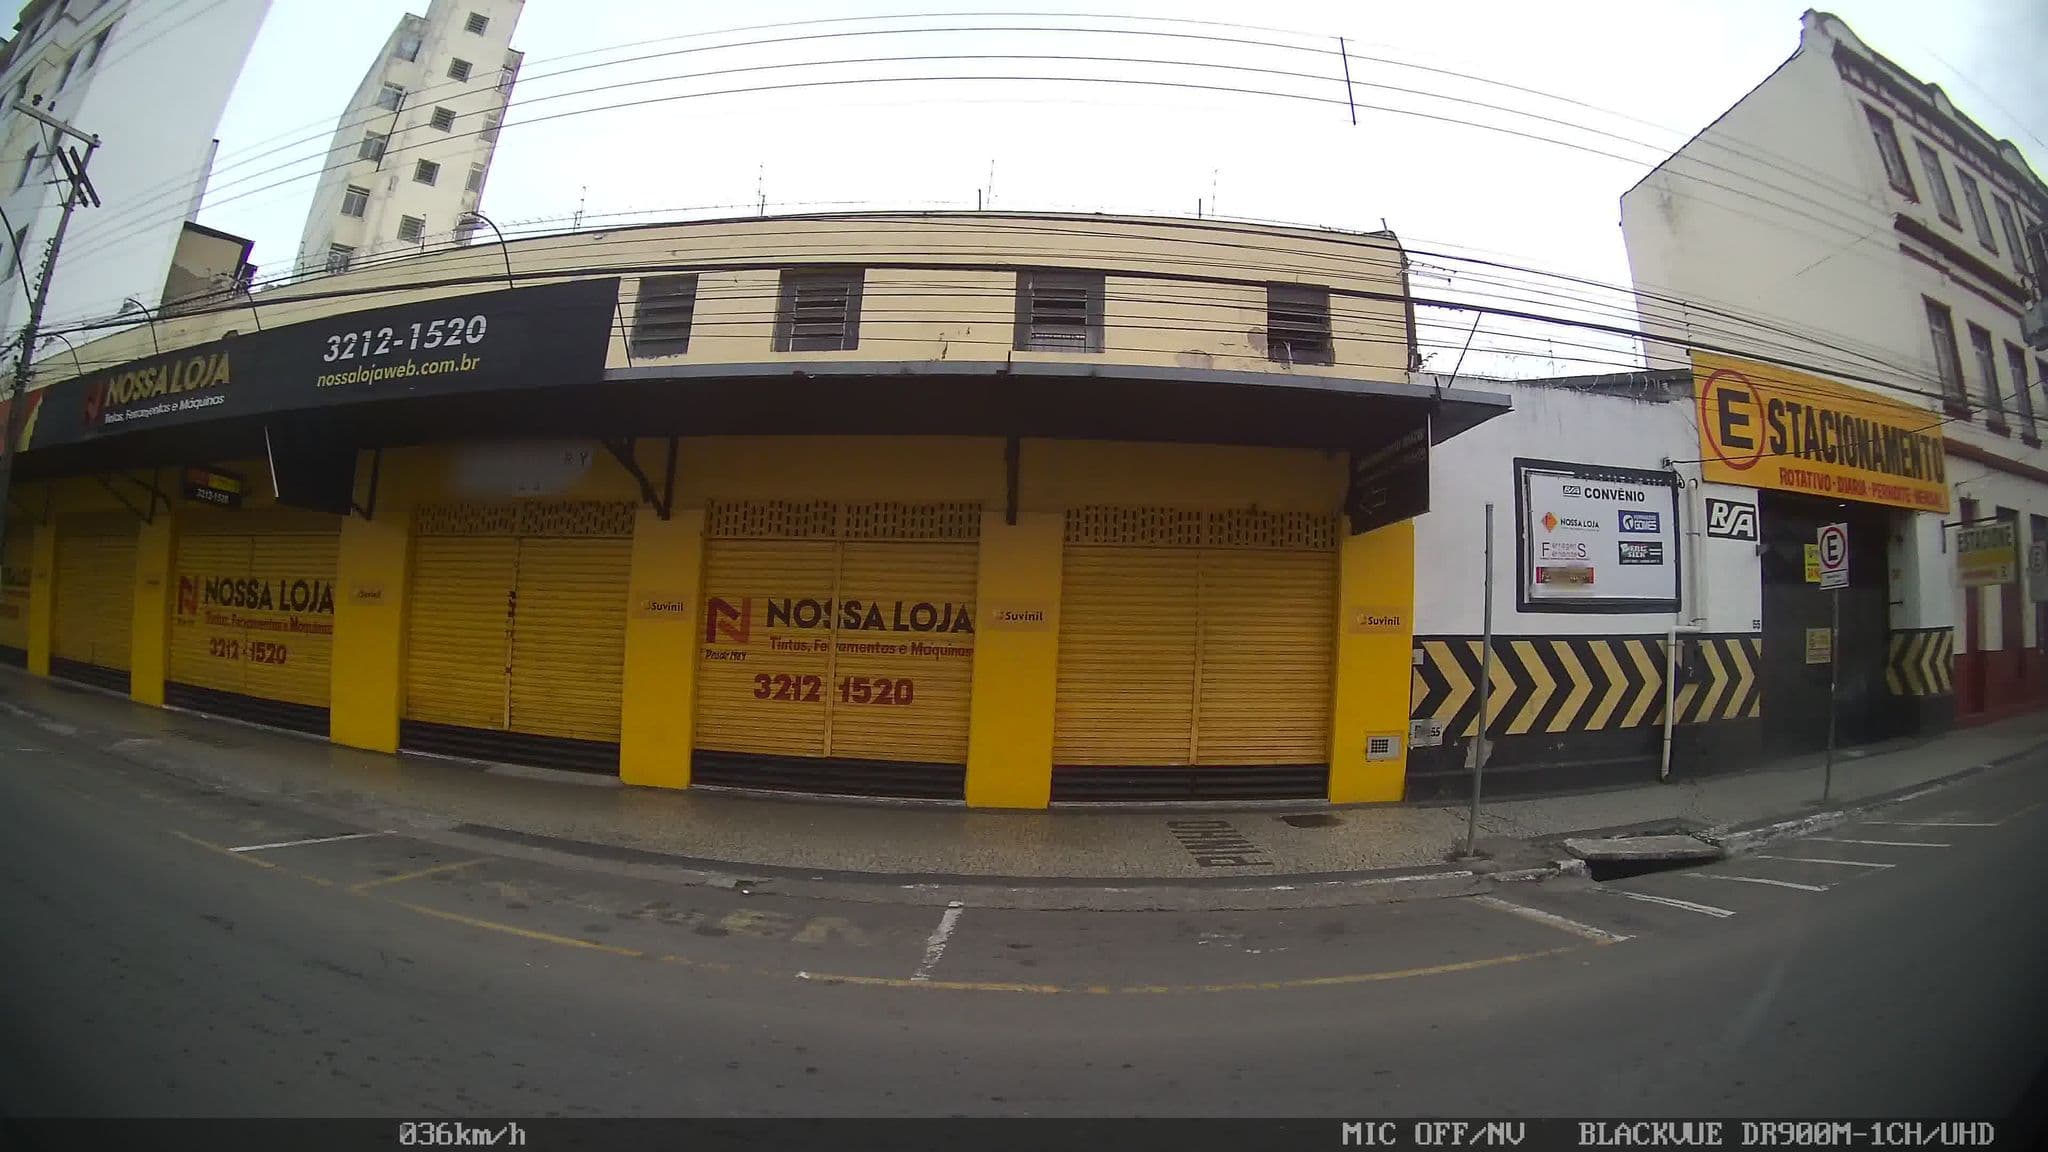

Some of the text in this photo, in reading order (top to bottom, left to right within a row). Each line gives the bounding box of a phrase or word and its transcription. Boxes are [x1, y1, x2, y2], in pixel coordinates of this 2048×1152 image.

[322, 314, 488, 363] 3212-1520
[104, 351, 231, 407] NOSSA LOJA
[316, 353, 481, 387] nossalojaweb.com.br
[1778, 466, 1832, 492] ROTATIVO
[1584, 486, 1645, 502] CONVÊNIO
[1560, 517, 1583, 527] NOSSA
[1583, 519, 1600, 529] LOJA
[1826, 534, 1839, 562] E
[204, 576, 335, 614] NOSSA LOJA
[651, 602, 684, 612] Suvinil
[767, 596, 975, 634] NOSSA LOJA
[1004, 610, 1044, 622] Suvinil
[1368, 616, 1401, 626] Suvinil
[899, 644, 906, 654] e
[754, 673, 915, 705] 3212 1520
